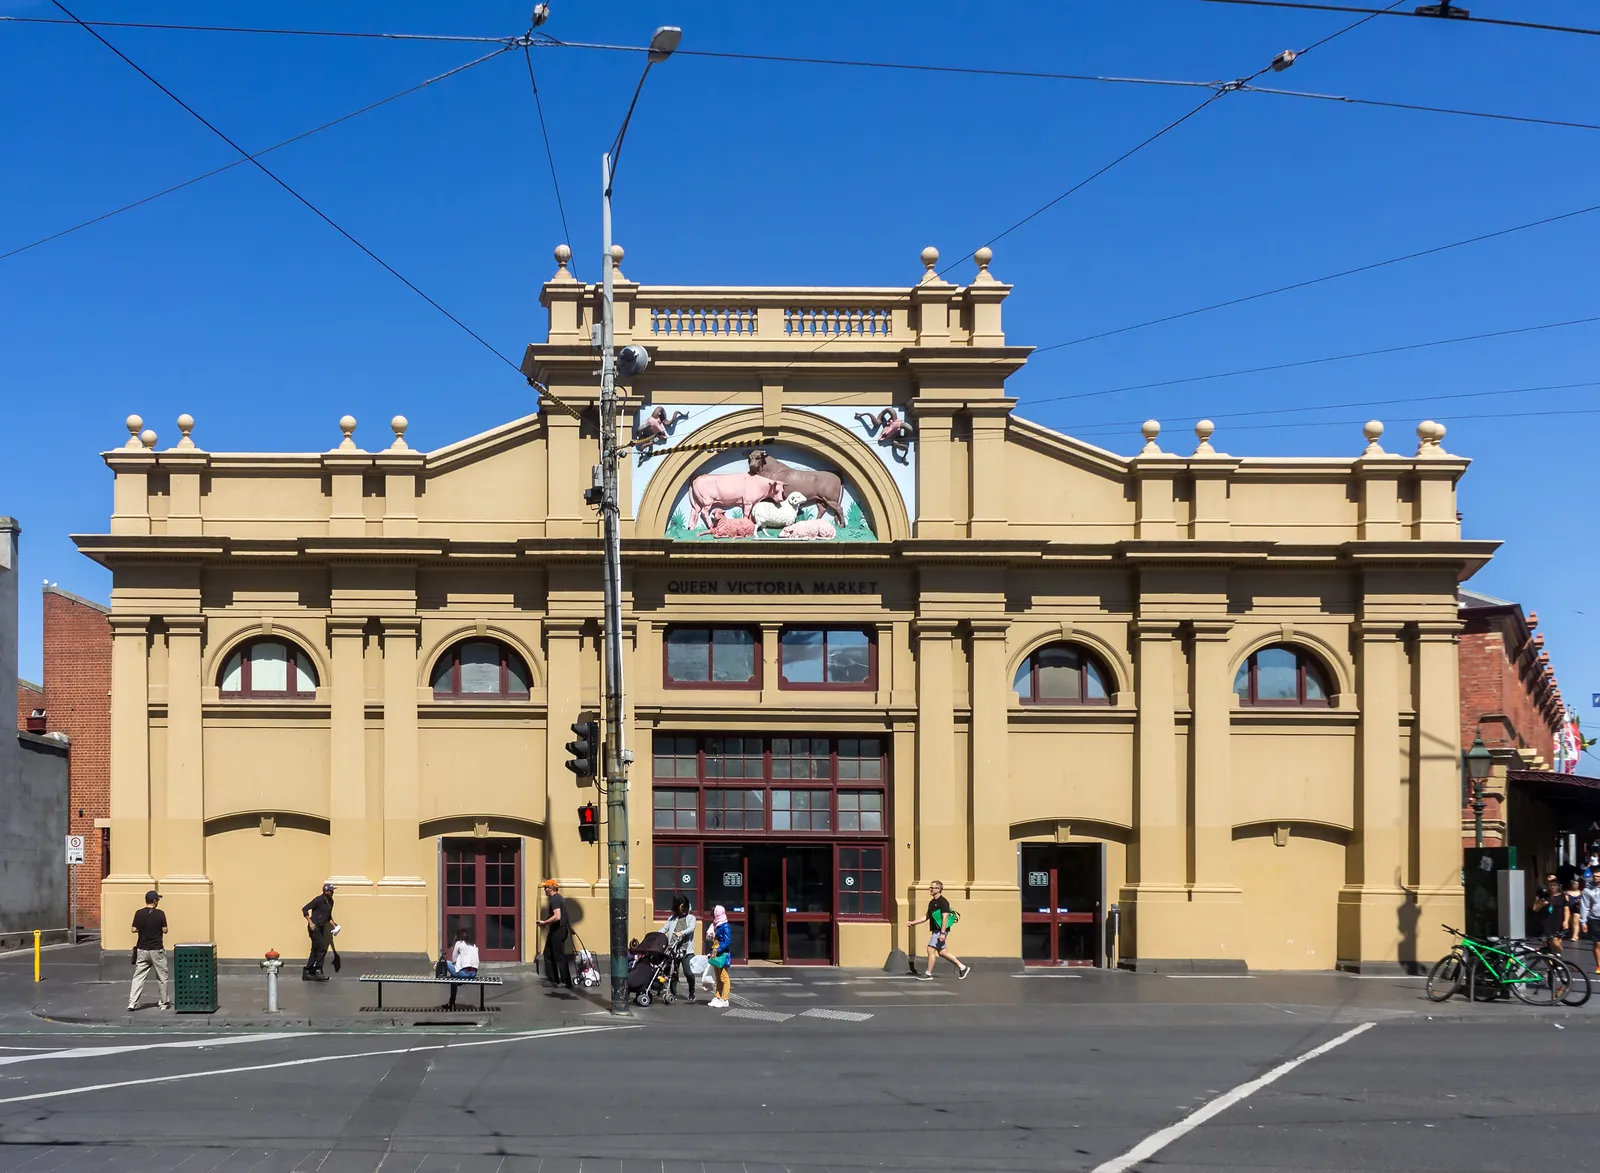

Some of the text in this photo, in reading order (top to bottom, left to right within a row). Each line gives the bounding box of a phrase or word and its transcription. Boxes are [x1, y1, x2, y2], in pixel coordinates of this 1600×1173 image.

[667, 581, 878, 594] QUEEN VICTORIA MARKET
